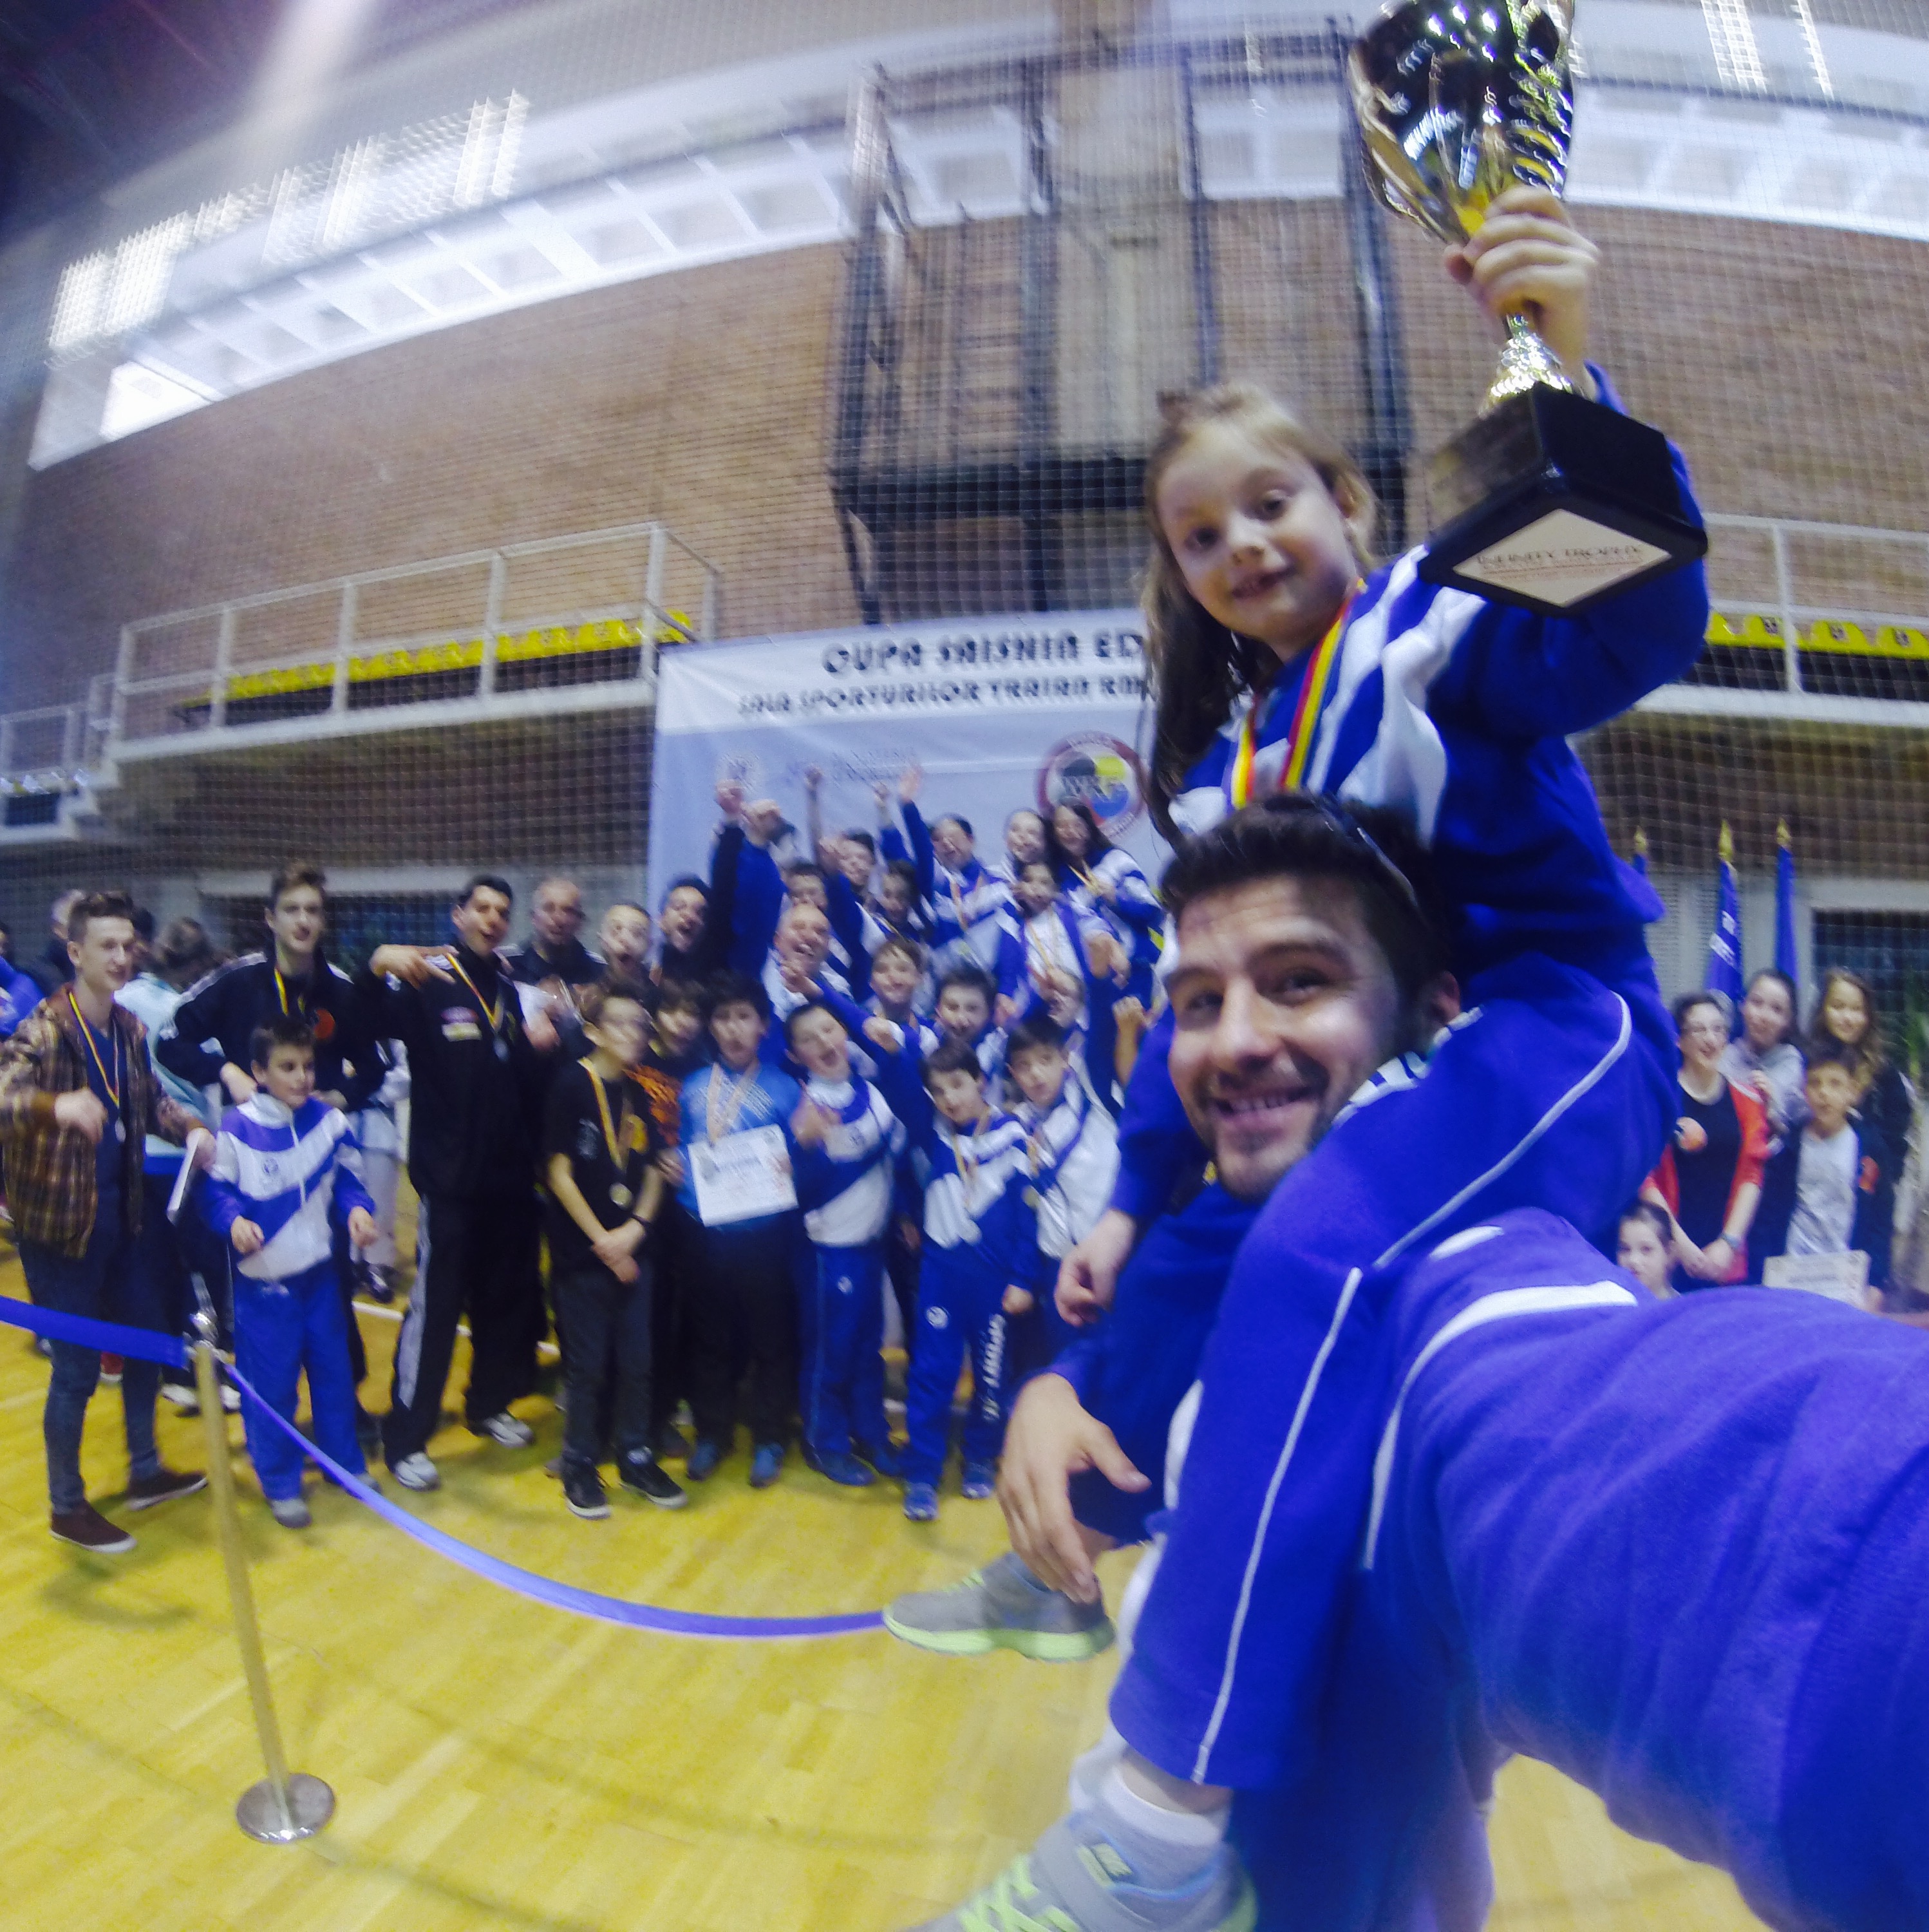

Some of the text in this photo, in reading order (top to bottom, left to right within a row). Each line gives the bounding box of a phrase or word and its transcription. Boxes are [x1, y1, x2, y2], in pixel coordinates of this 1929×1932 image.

[1565, 545, 1644, 558] TROPHY
[820, 636, 921, 678] CUPA
[800, 681, 979, 710] SPORTURILOR
